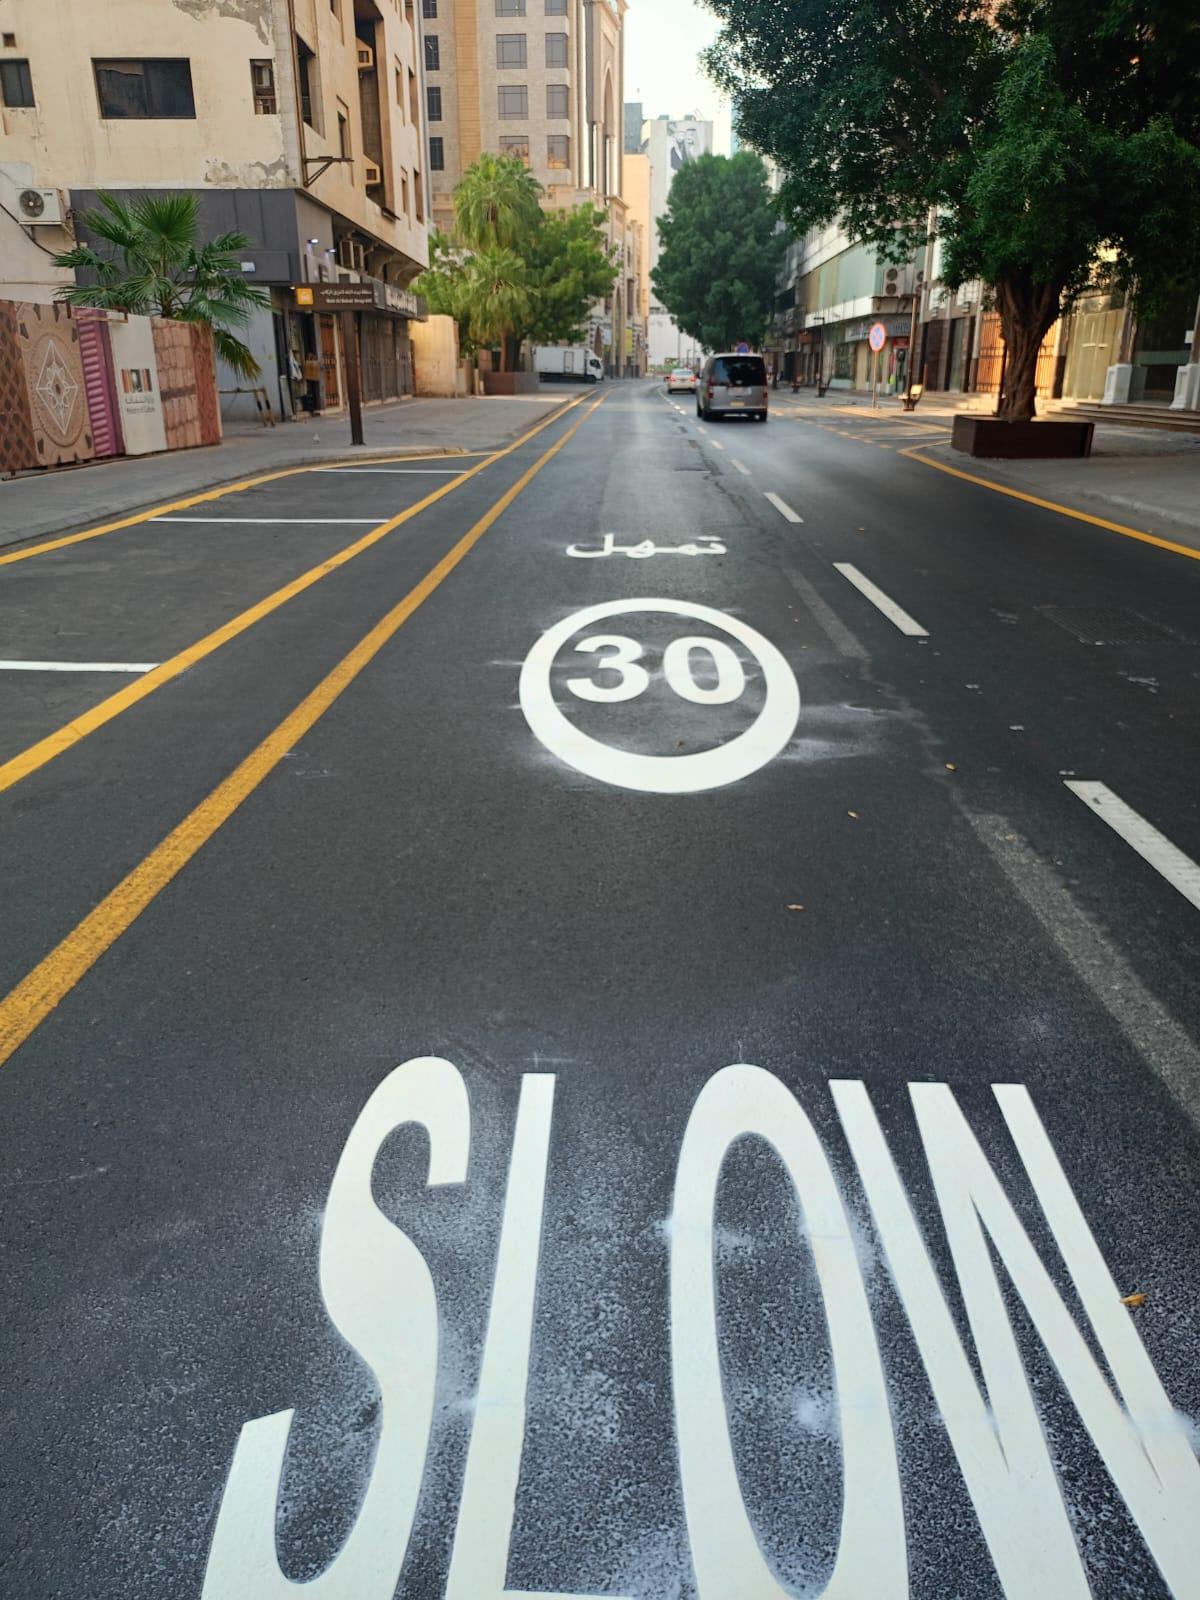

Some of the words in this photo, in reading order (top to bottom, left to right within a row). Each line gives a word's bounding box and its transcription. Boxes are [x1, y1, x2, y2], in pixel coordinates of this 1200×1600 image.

[565, 532, 728, 559] تمهل
[566, 634, 746, 705] 30
[200, 1056, 1200, 1600] SLOW
